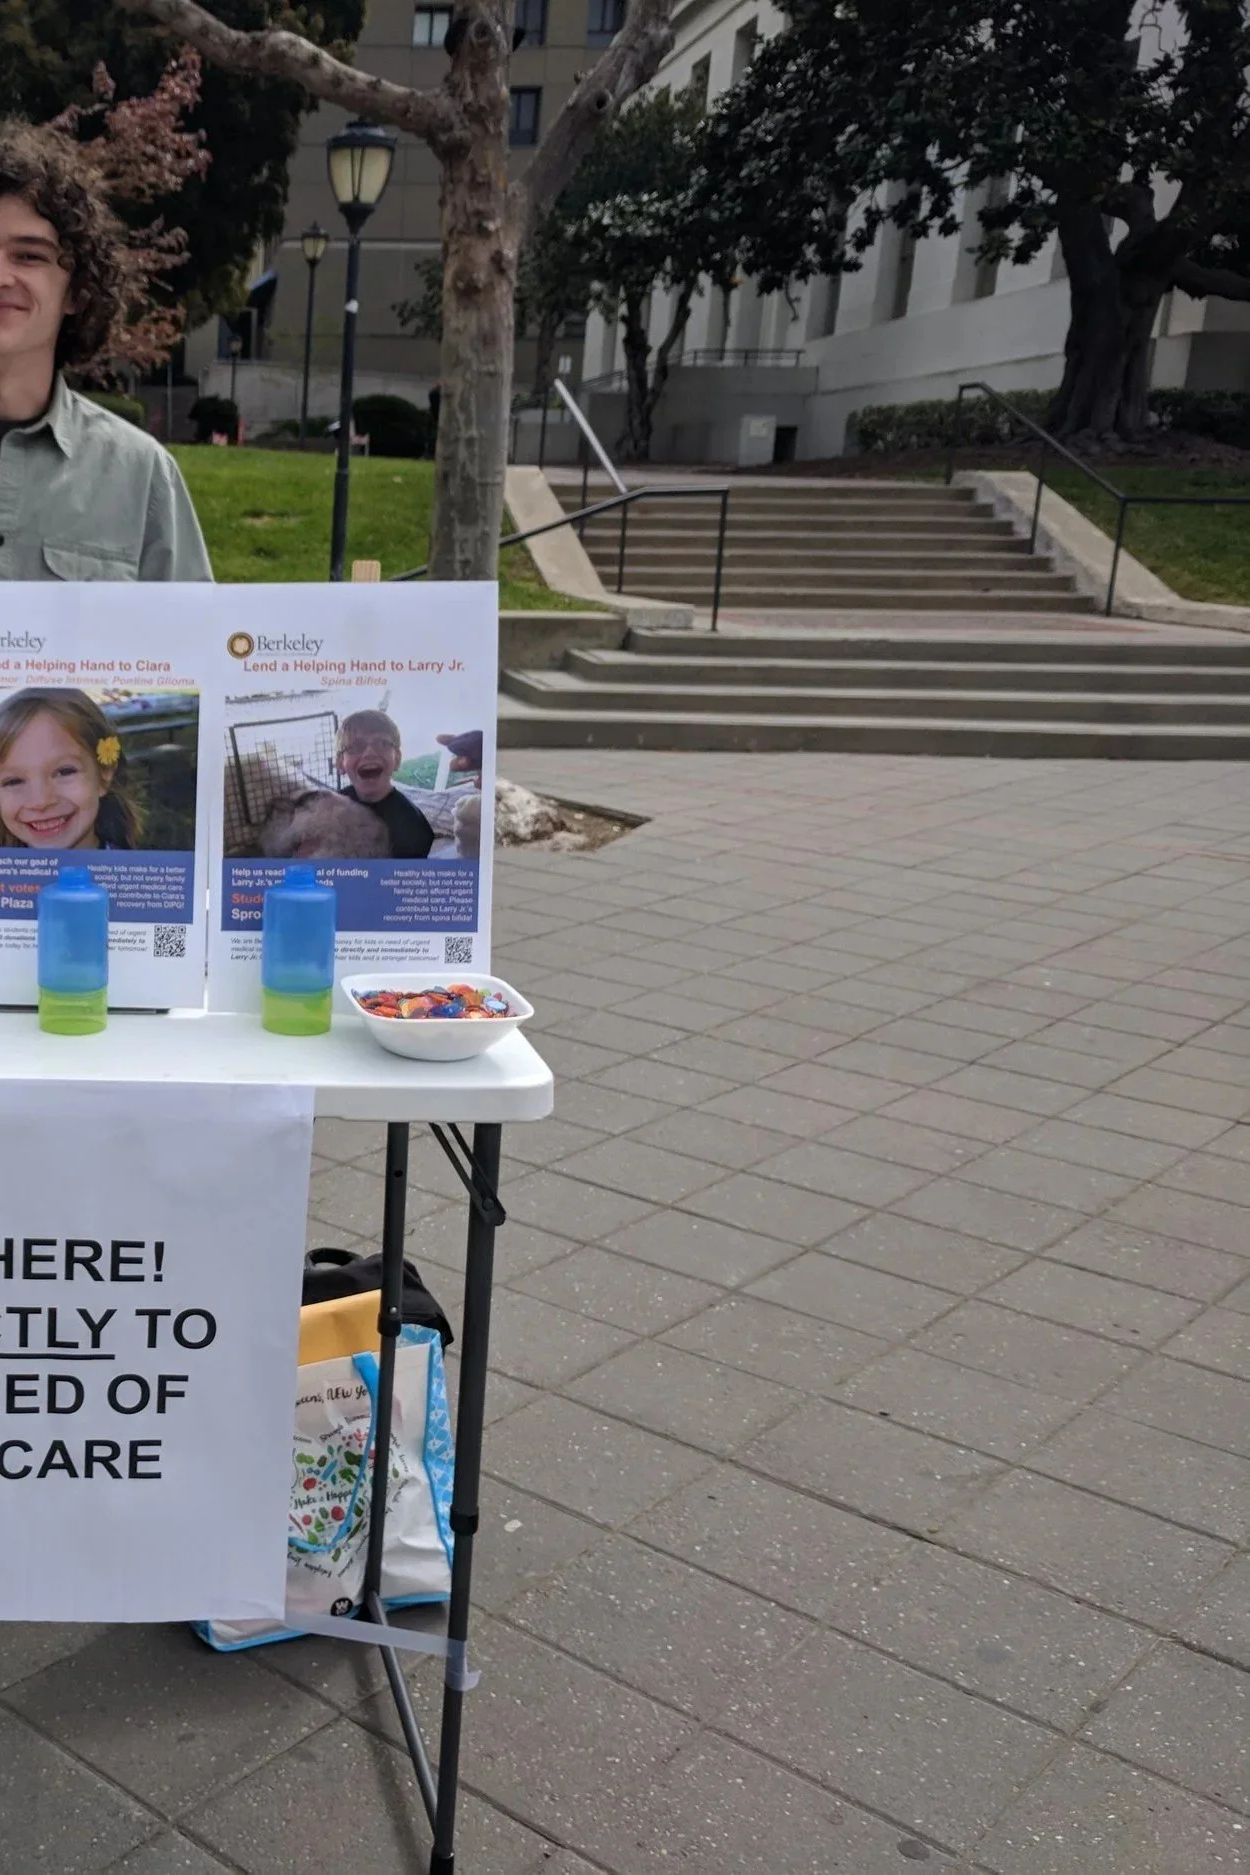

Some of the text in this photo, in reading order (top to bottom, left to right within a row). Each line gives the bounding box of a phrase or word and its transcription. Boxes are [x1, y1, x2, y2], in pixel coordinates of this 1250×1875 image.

[257, 634, 323, 656] Berkeley
[14, 662, 21, 670] a
[26, 659, 75, 673] Helping
[80, 660, 114, 671] Hand
[119, 661, 131, 671] to
[244, 660, 465, 674] Lend a Helping Hand to Larry Jr.
[321, 676, 387, 687] Spina Bifida
[232, 868, 250, 877] Help
[336, 869, 368, 878] funding
[232, 879, 252, 887] Larry
[1, 897, 33, 909] Plaza
[232, 908, 263, 921] Spro
[134, 1308, 217, 1350] TO
[107, 1373, 189, 1415] OF
